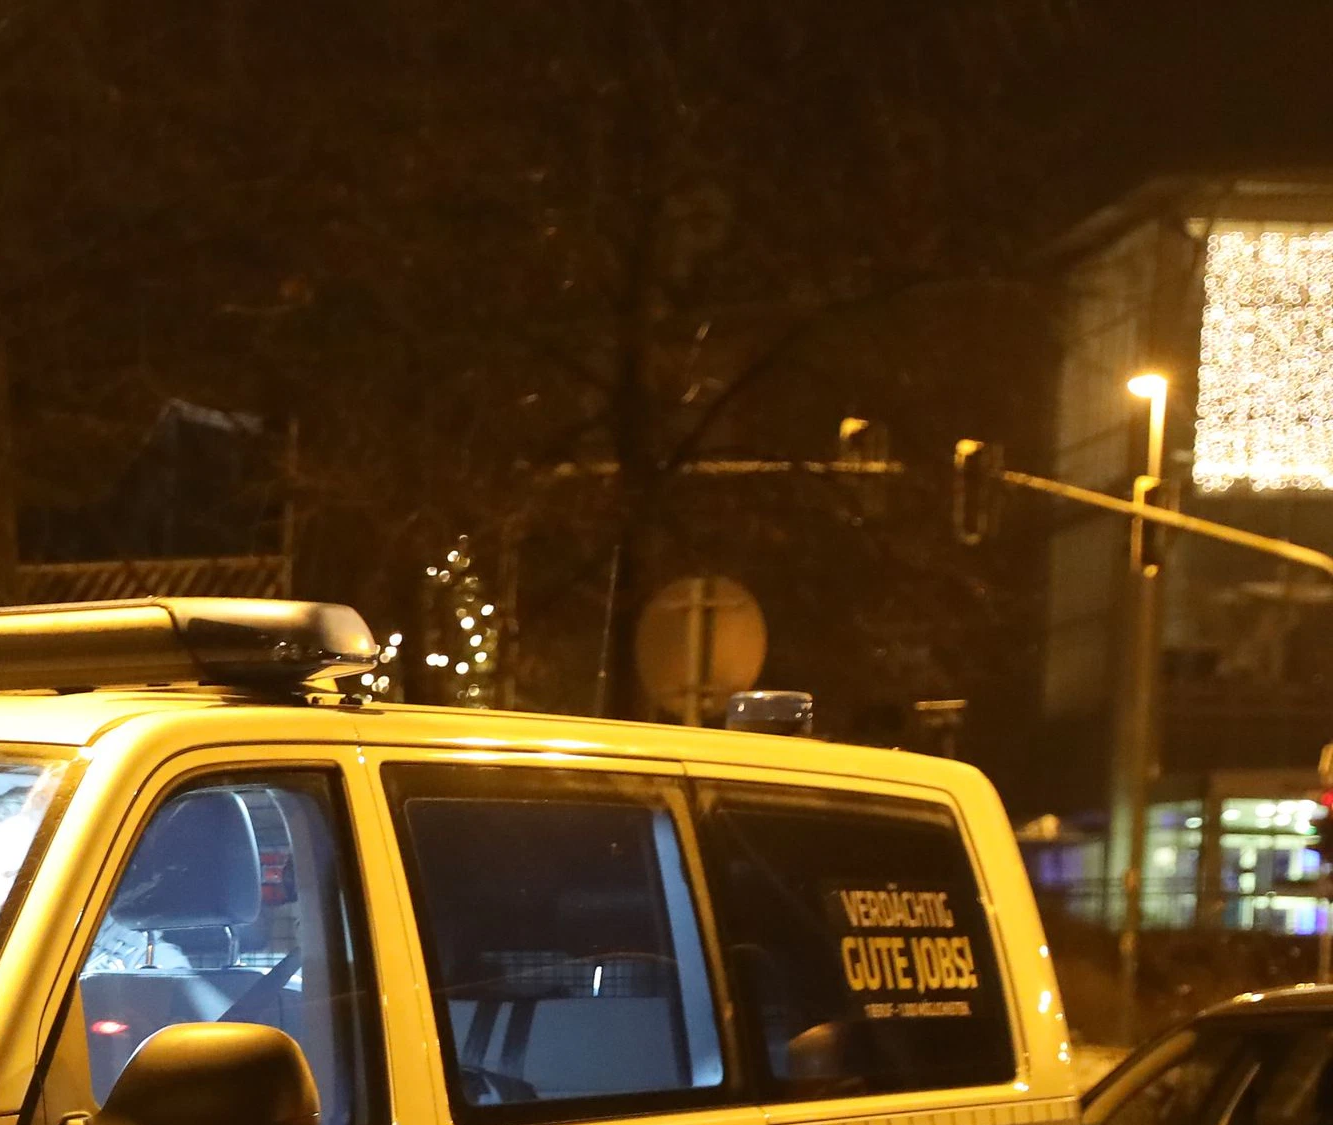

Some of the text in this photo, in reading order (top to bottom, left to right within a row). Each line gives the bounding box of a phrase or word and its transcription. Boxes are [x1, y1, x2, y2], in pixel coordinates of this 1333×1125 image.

[840, 882, 955, 929] VERDÄCHTIG
[841, 935, 979, 994] GUTE JOBS!
